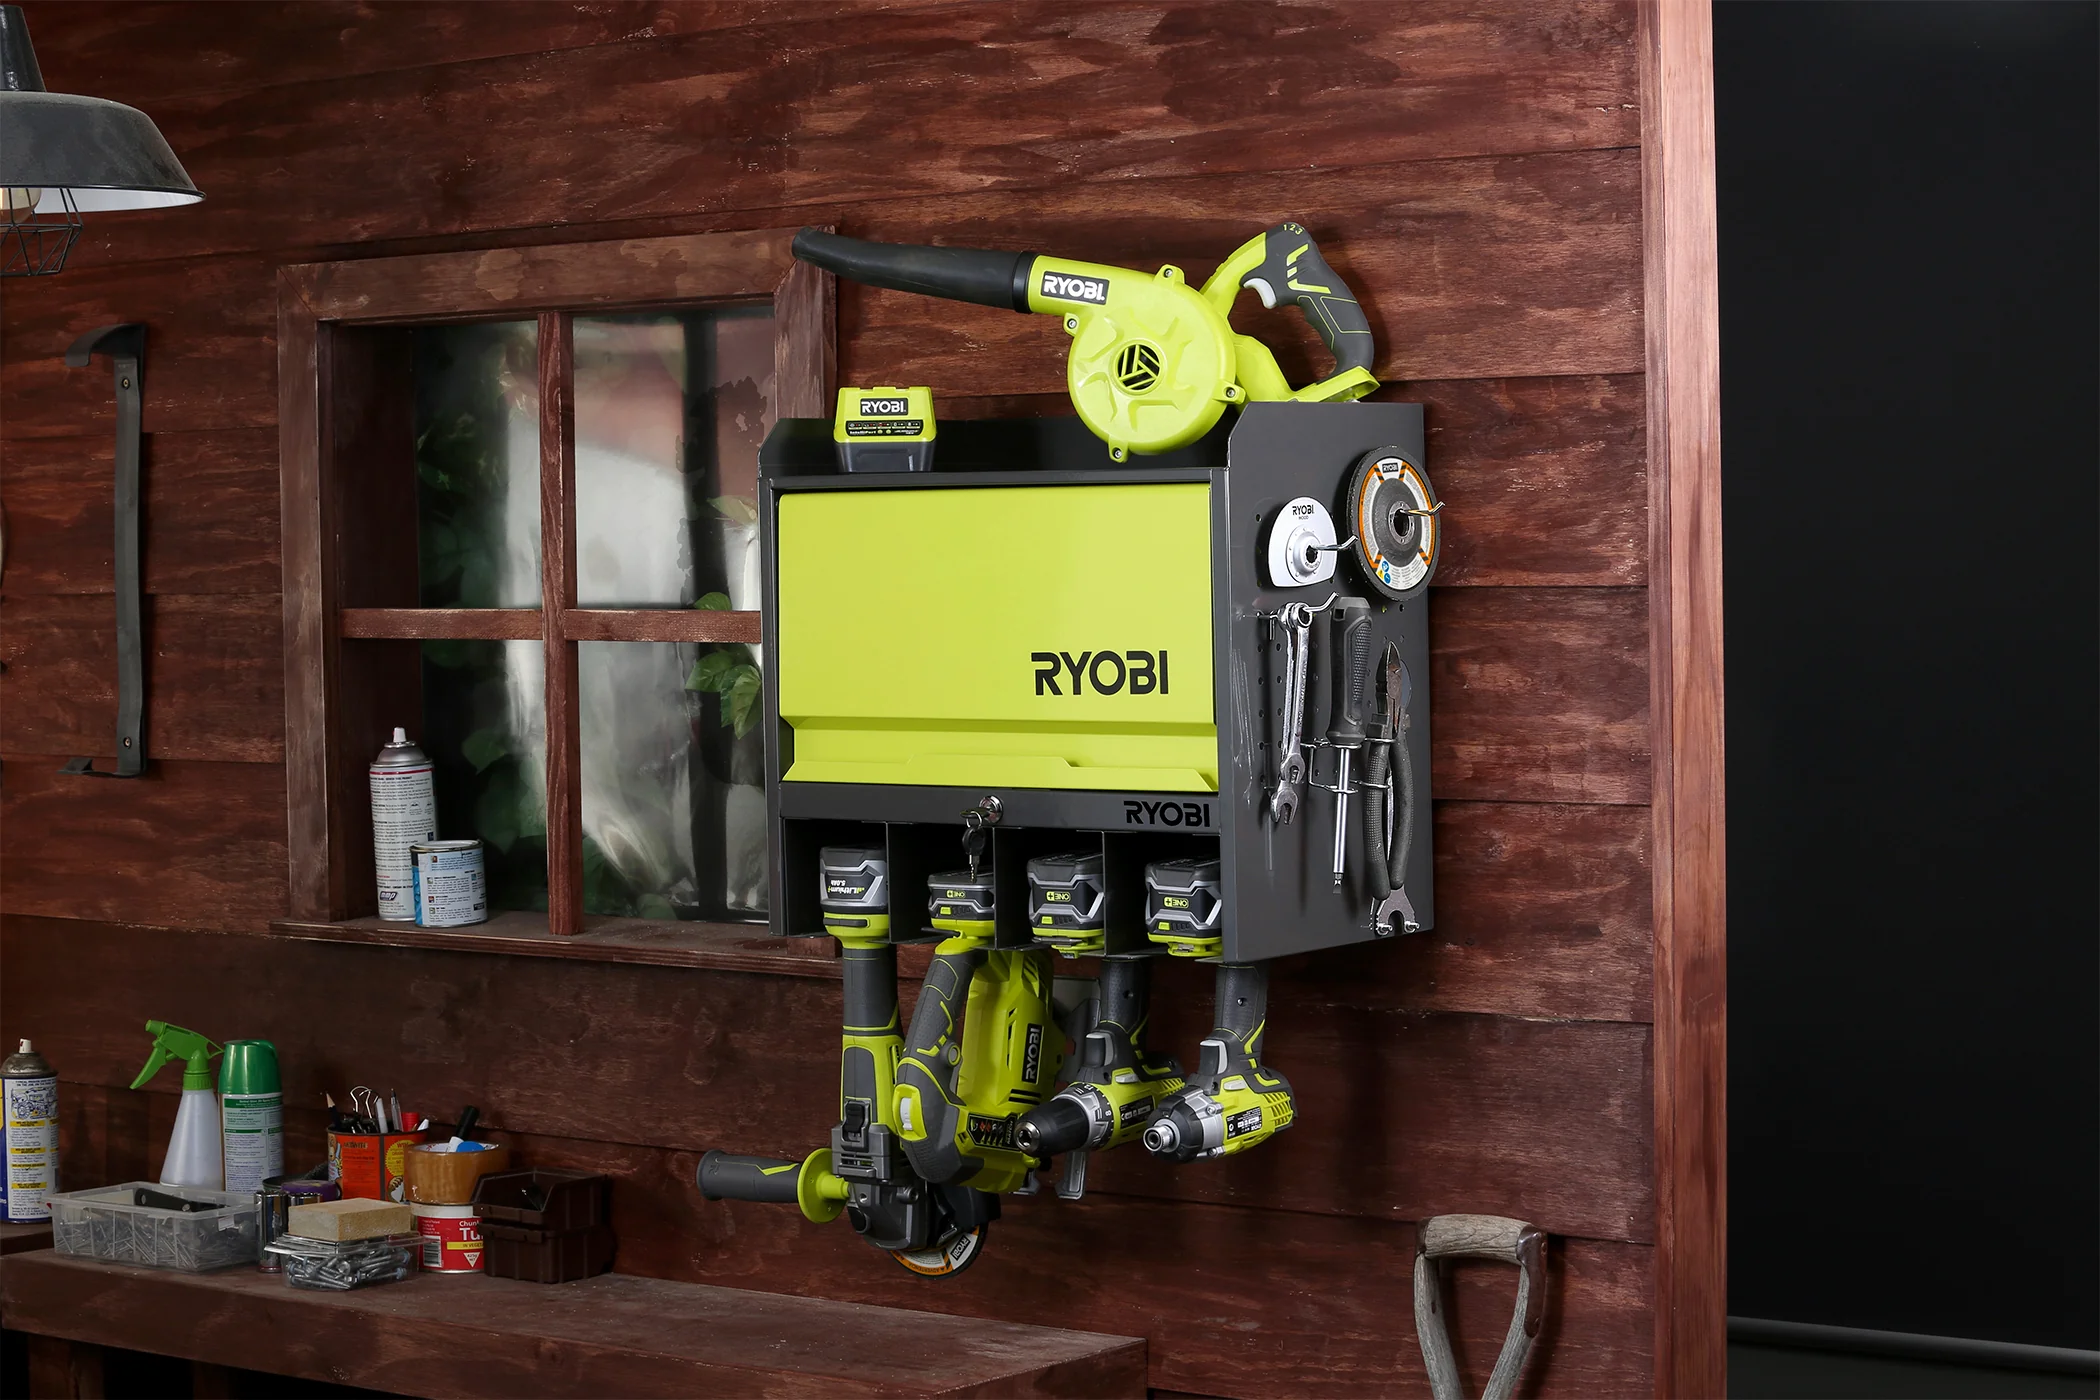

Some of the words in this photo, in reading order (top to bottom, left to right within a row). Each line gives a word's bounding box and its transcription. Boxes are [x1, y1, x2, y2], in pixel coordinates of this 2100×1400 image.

[1283, 223, 1287, 231] 1
[1289, 223, 1296, 232] 2
[1295, 227, 1303, 235] 3
[1042, 273, 1106, 301] RYOBI
[861, 400, 905, 413] RYOBI
[1382, 463, 1398, 472] RYOBI
[1292, 504, 1315, 516] RYOBI
[1031, 650, 1169, 696] RYOBI
[1123, 801, 1211, 828] RYOBI
[1025, 1025, 1041, 1081] RYOBI
[459, 1227, 483, 1241] Tu
[952, 1237, 969, 1258] RYOBI
